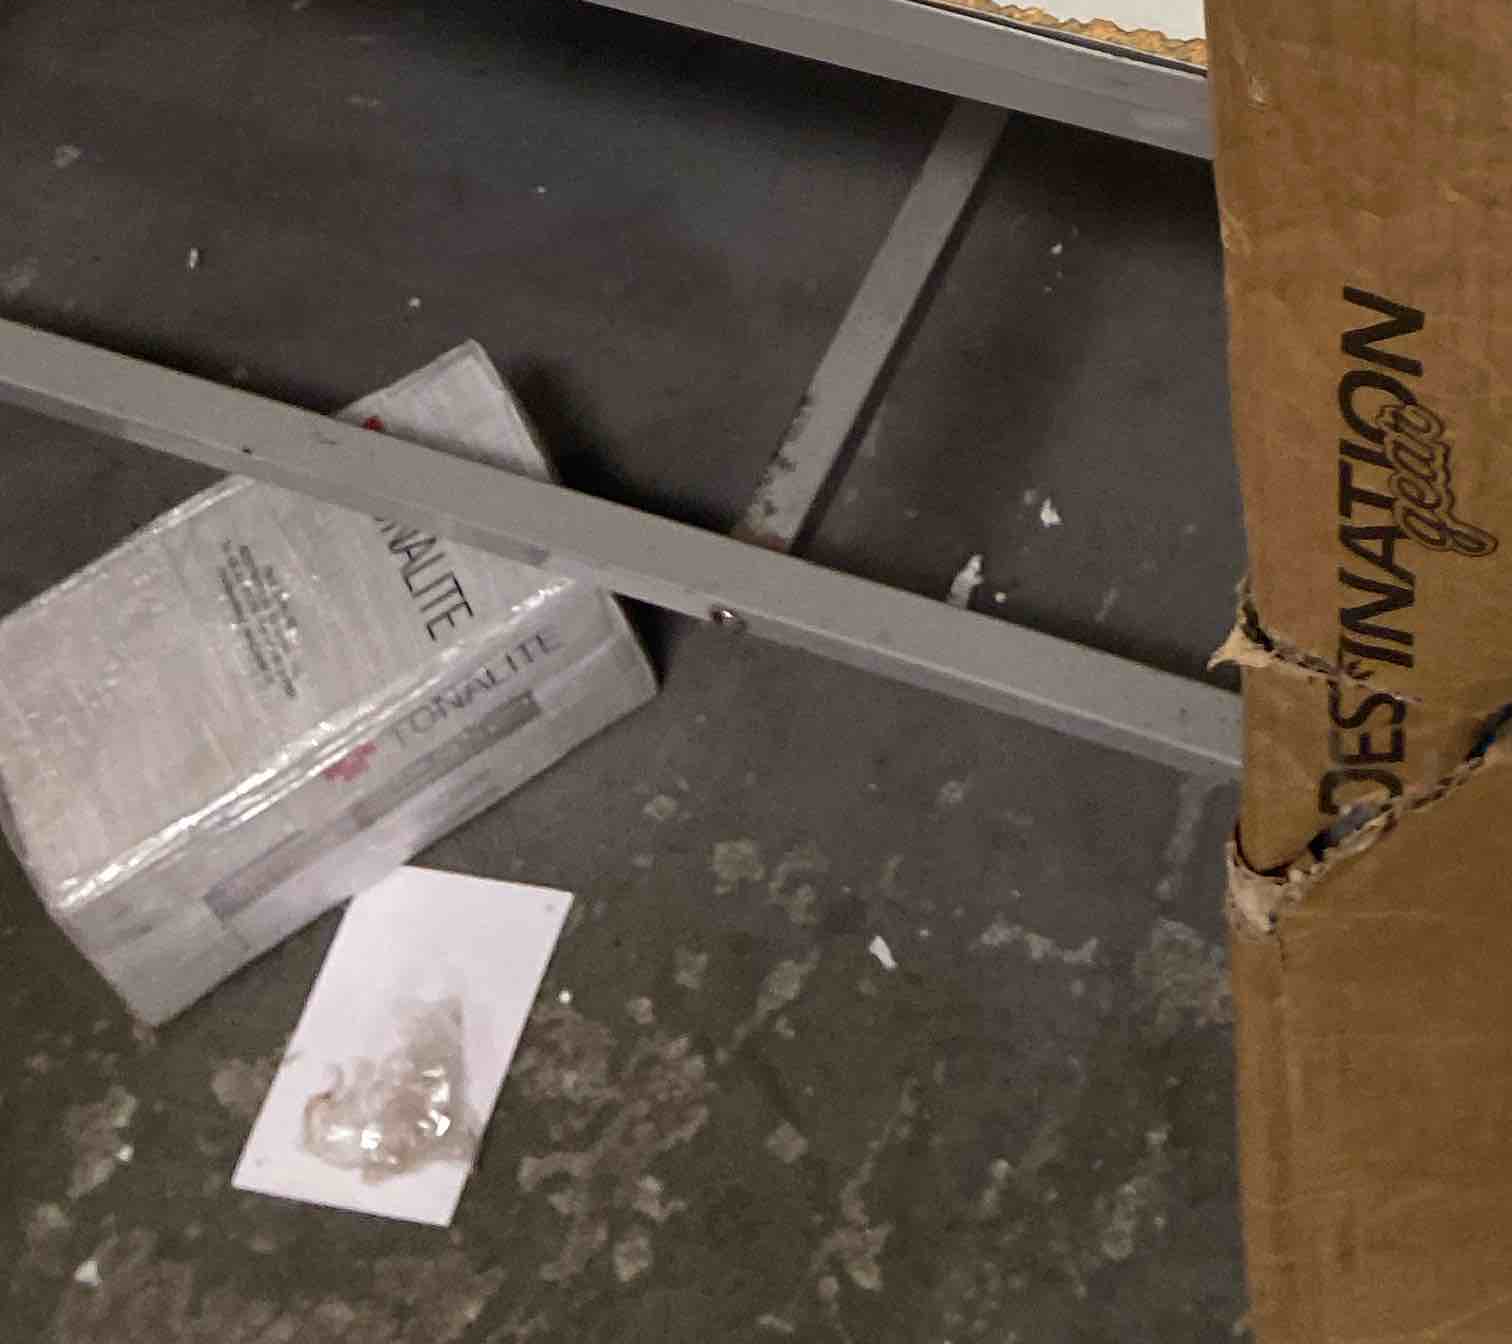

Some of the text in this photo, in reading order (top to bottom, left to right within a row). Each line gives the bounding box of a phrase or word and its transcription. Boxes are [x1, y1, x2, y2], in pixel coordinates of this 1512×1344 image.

[1377, 404, 1498, 557] gear
[375, 515, 474, 642] NALITE
[388, 632, 560, 748] TONALITE
